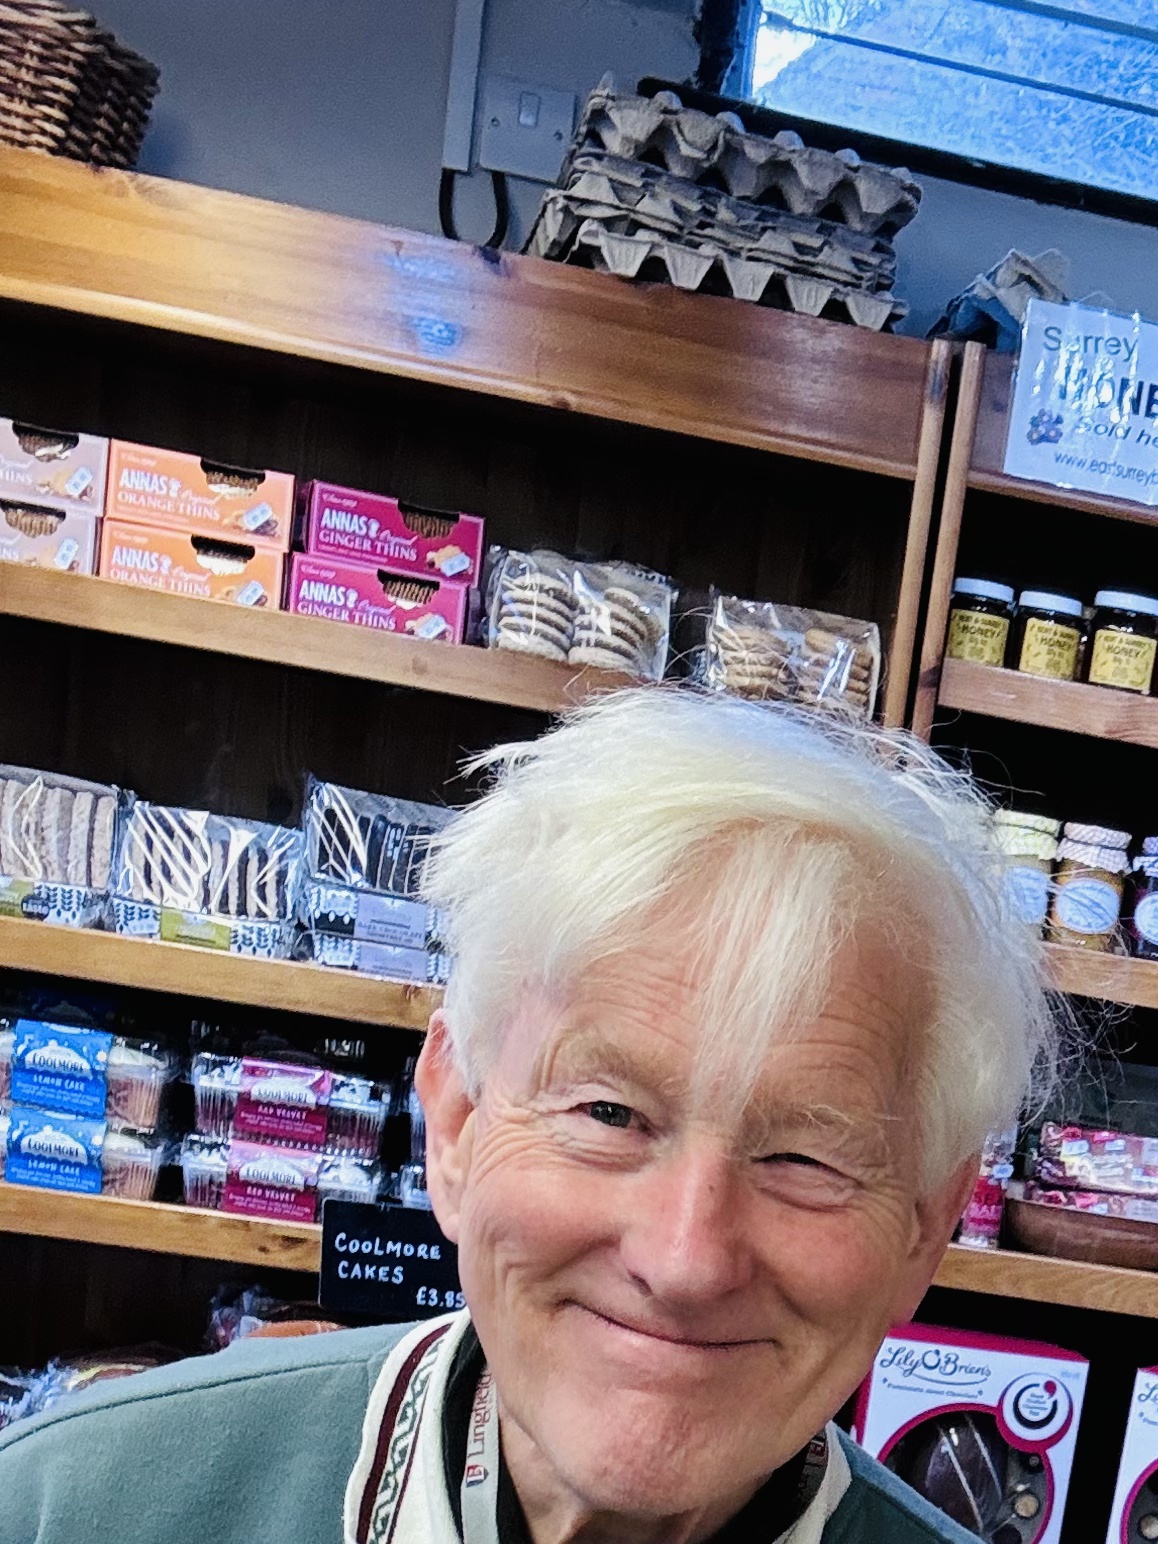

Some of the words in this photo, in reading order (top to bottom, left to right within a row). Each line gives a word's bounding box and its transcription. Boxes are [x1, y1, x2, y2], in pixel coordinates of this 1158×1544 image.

[0, 468, 33, 484] HINS
[119, 468, 168, 496] ANNAS
[117, 491, 174, 512] ORANGE
[179, 502, 220, 521] THINS
[320, 508, 368, 535] ANNAS
[111, 546, 160, 572] ANNAS
[318, 530, 371, 553] GINGER
[375, 541, 417, 562] THINS
[109, 568, 164, 589] ORANGE
[169, 579, 211, 597] THINS
[298, 580, 346, 607] ANNAS
[297, 601, 349, 622] GINGER
[352, 611, 396, 631] THINS
[32, 1052, 84, 1072] COOLMORE
[33, 1073, 62, 1086] LEMON
[64, 1079, 86, 1091] CAKE
[28, 1138, 80, 1158] COOLMORE
[27, 1159, 57, 1172] LEMON
[59, 1163, 82, 1176] CAKE
[334, 1232, 441, 1260] COOLMORE
[338, 1260, 404, 1285] CAKES
[879, 1346, 922, 1377] Lily
[466, 1373, 492, 1459] Lingfield
